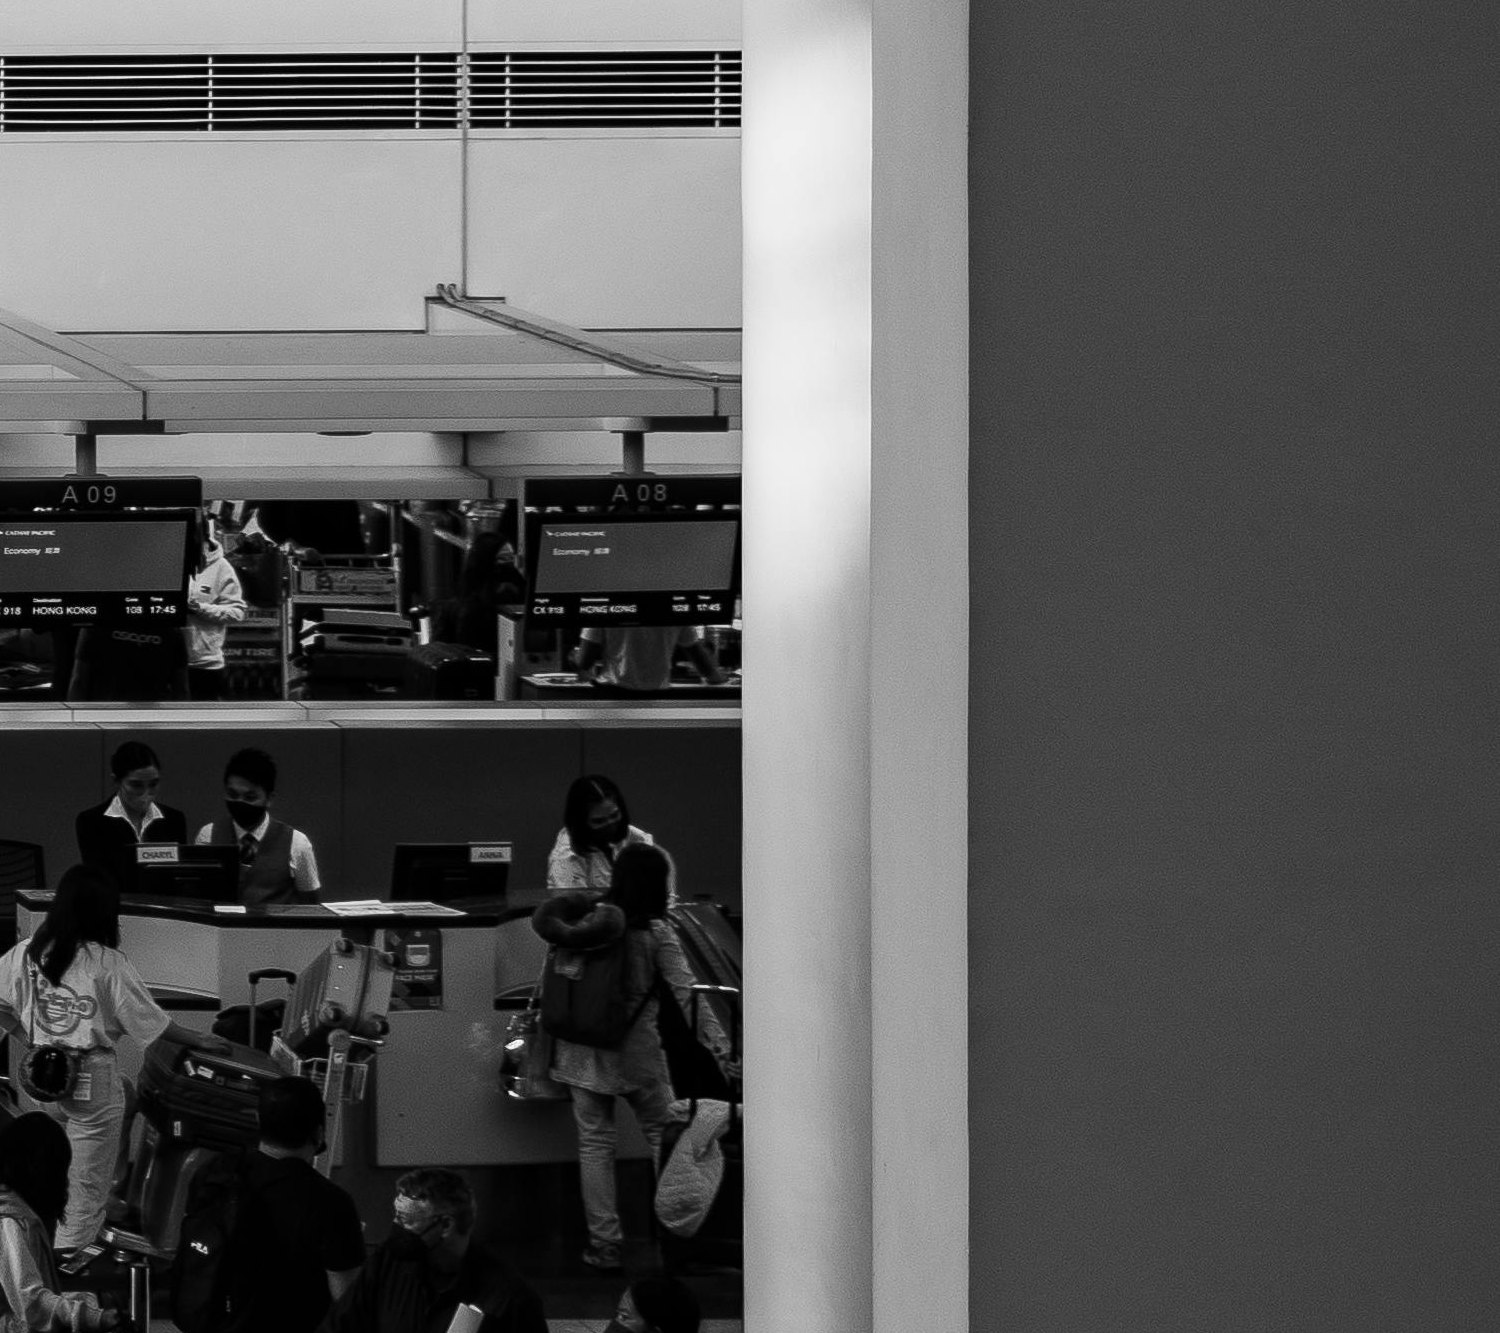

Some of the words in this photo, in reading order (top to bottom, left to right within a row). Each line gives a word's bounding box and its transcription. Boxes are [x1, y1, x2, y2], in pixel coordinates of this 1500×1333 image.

[62, 485, 79, 503] A
[87, 485, 117, 504] 09
[611, 483, 629, 502] A
[636, 483, 668, 502] 08
[4, 547, 42, 556] Economy
[3, 607, 22, 615] 918
[32, 607, 64, 615] HONG
[66, 606, 97, 615] KONG
[149, 606, 176, 614] 17:45
[142, 851, 174, 860] CHARYL
